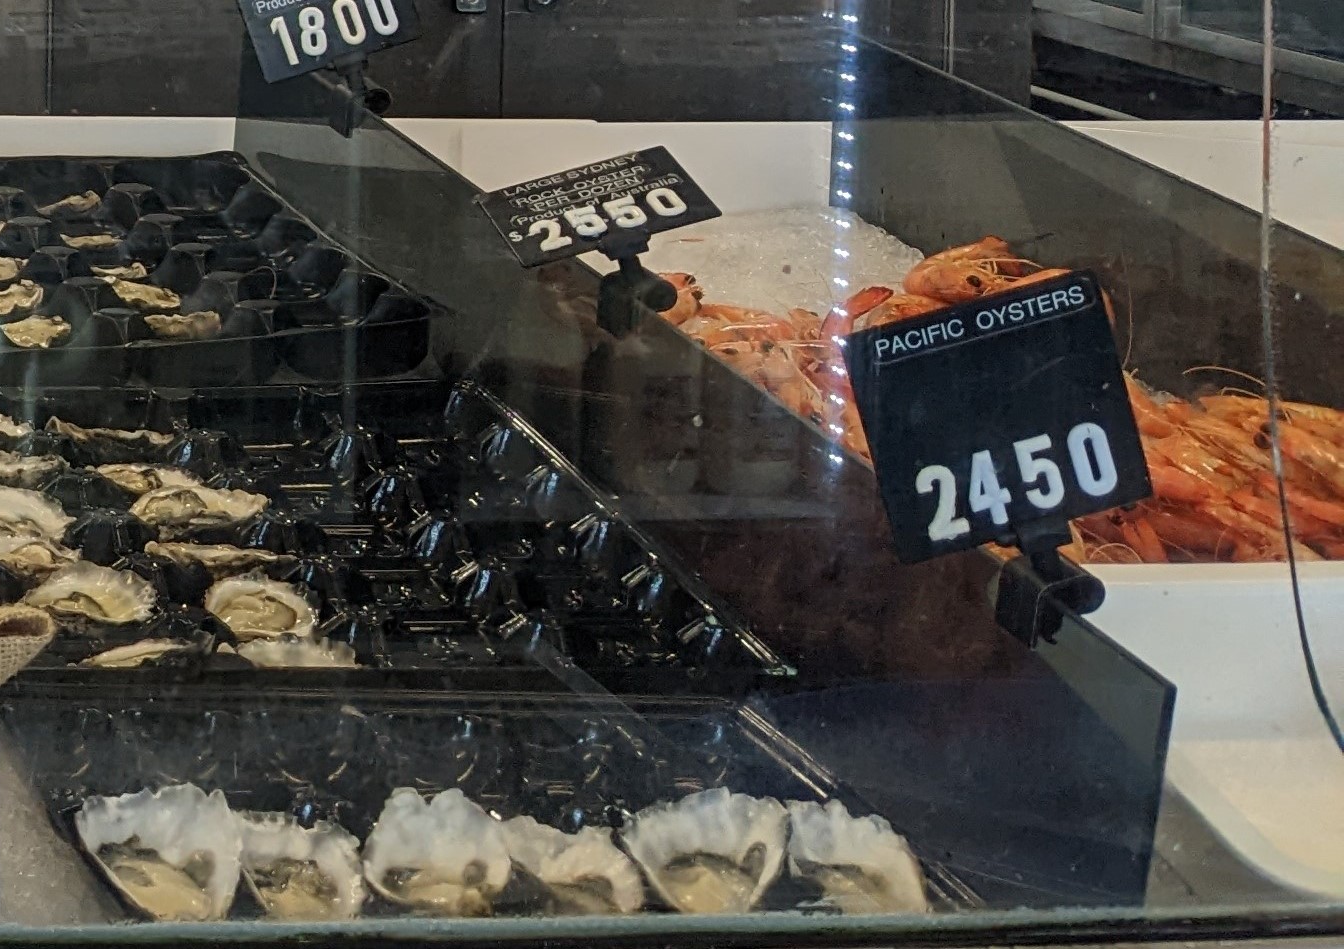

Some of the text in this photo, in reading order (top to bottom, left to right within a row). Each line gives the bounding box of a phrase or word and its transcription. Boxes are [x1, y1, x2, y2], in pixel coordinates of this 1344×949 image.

[255, 0, 302, 14] Produ
[270, 0, 399, 65] 1800
[503, 153, 640, 197] LARGE SYDNEY
[514, 164, 646, 207] ROCK OYSTER
[533, 176, 640, 212] PER DOZEN
[874, 285, 1086, 359] PACIFIC OYSTERS
[915, 422, 1119, 541] 2450
